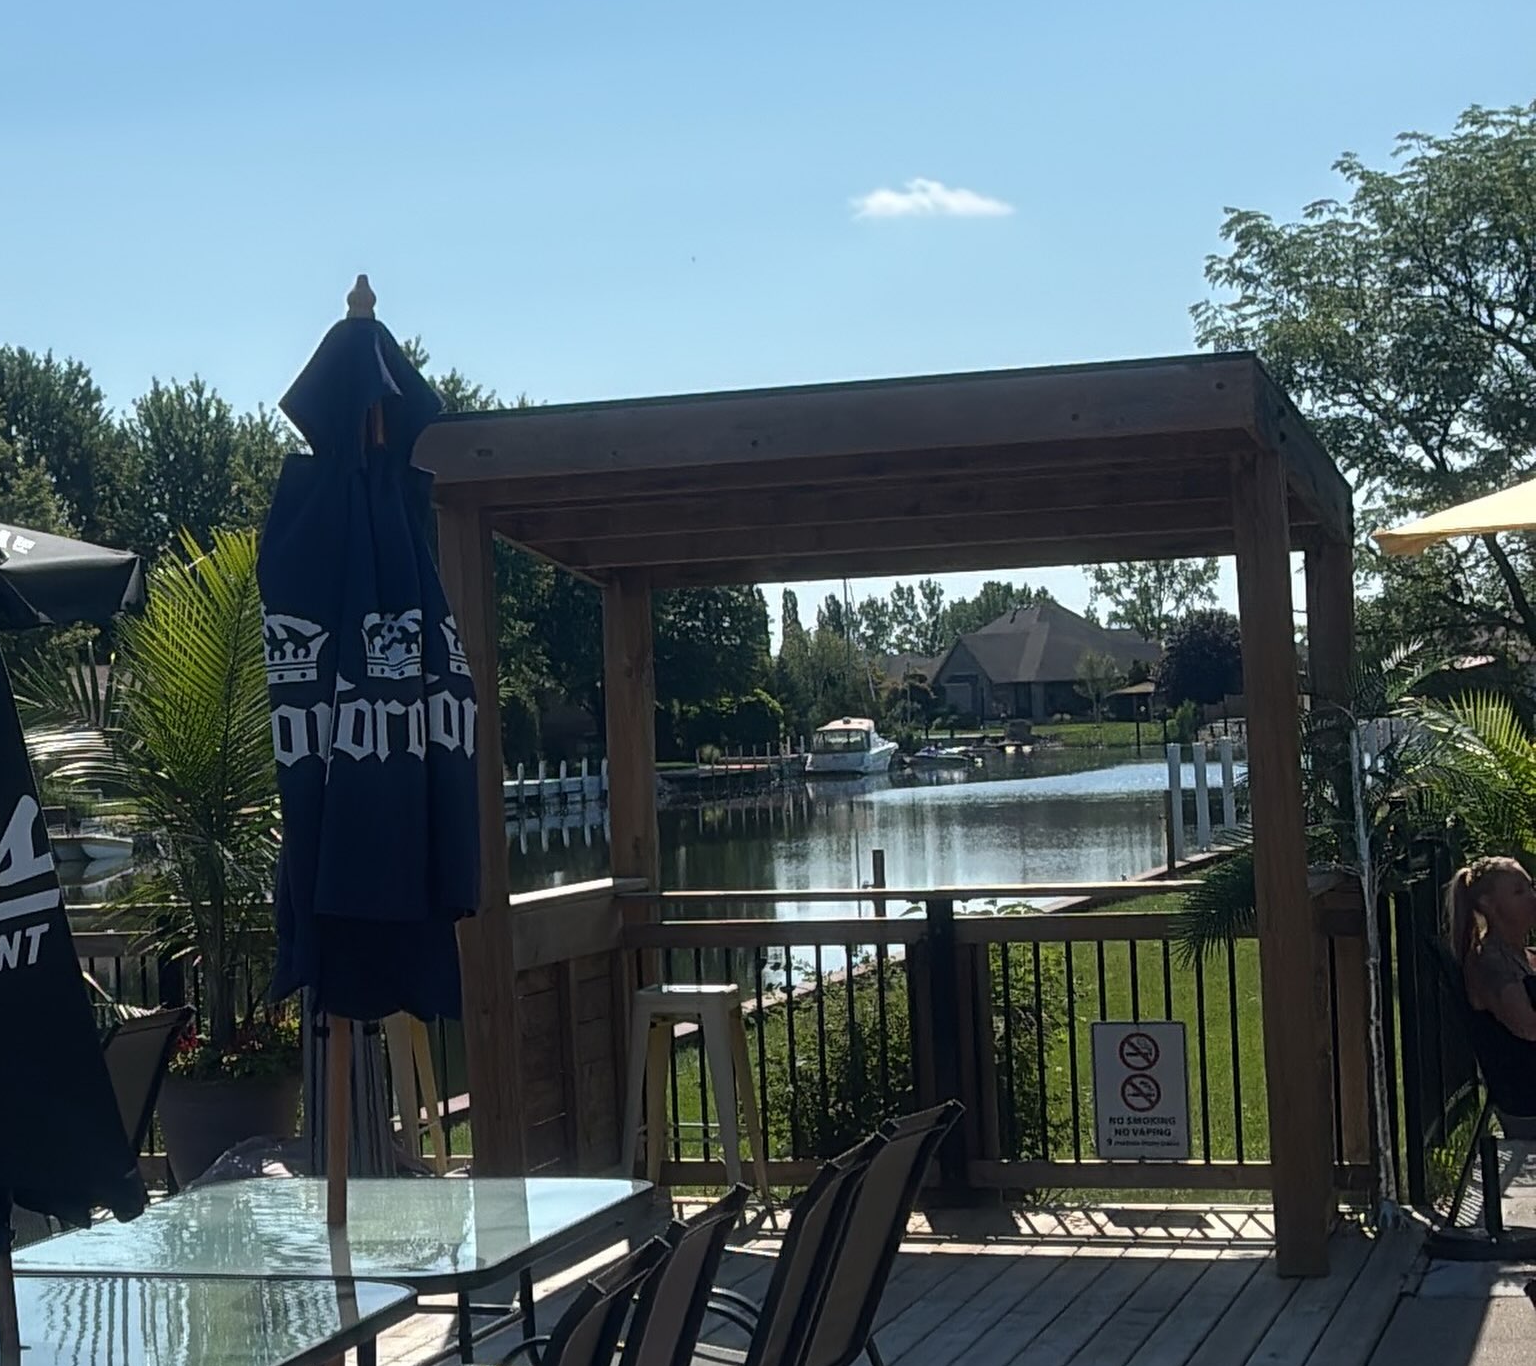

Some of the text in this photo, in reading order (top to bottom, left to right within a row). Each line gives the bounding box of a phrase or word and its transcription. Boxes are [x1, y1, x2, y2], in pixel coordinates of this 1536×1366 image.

[1108, 1116, 1177, 1126] NO SMOKING
[1114, 1127, 1172, 1137] NO VAPING
